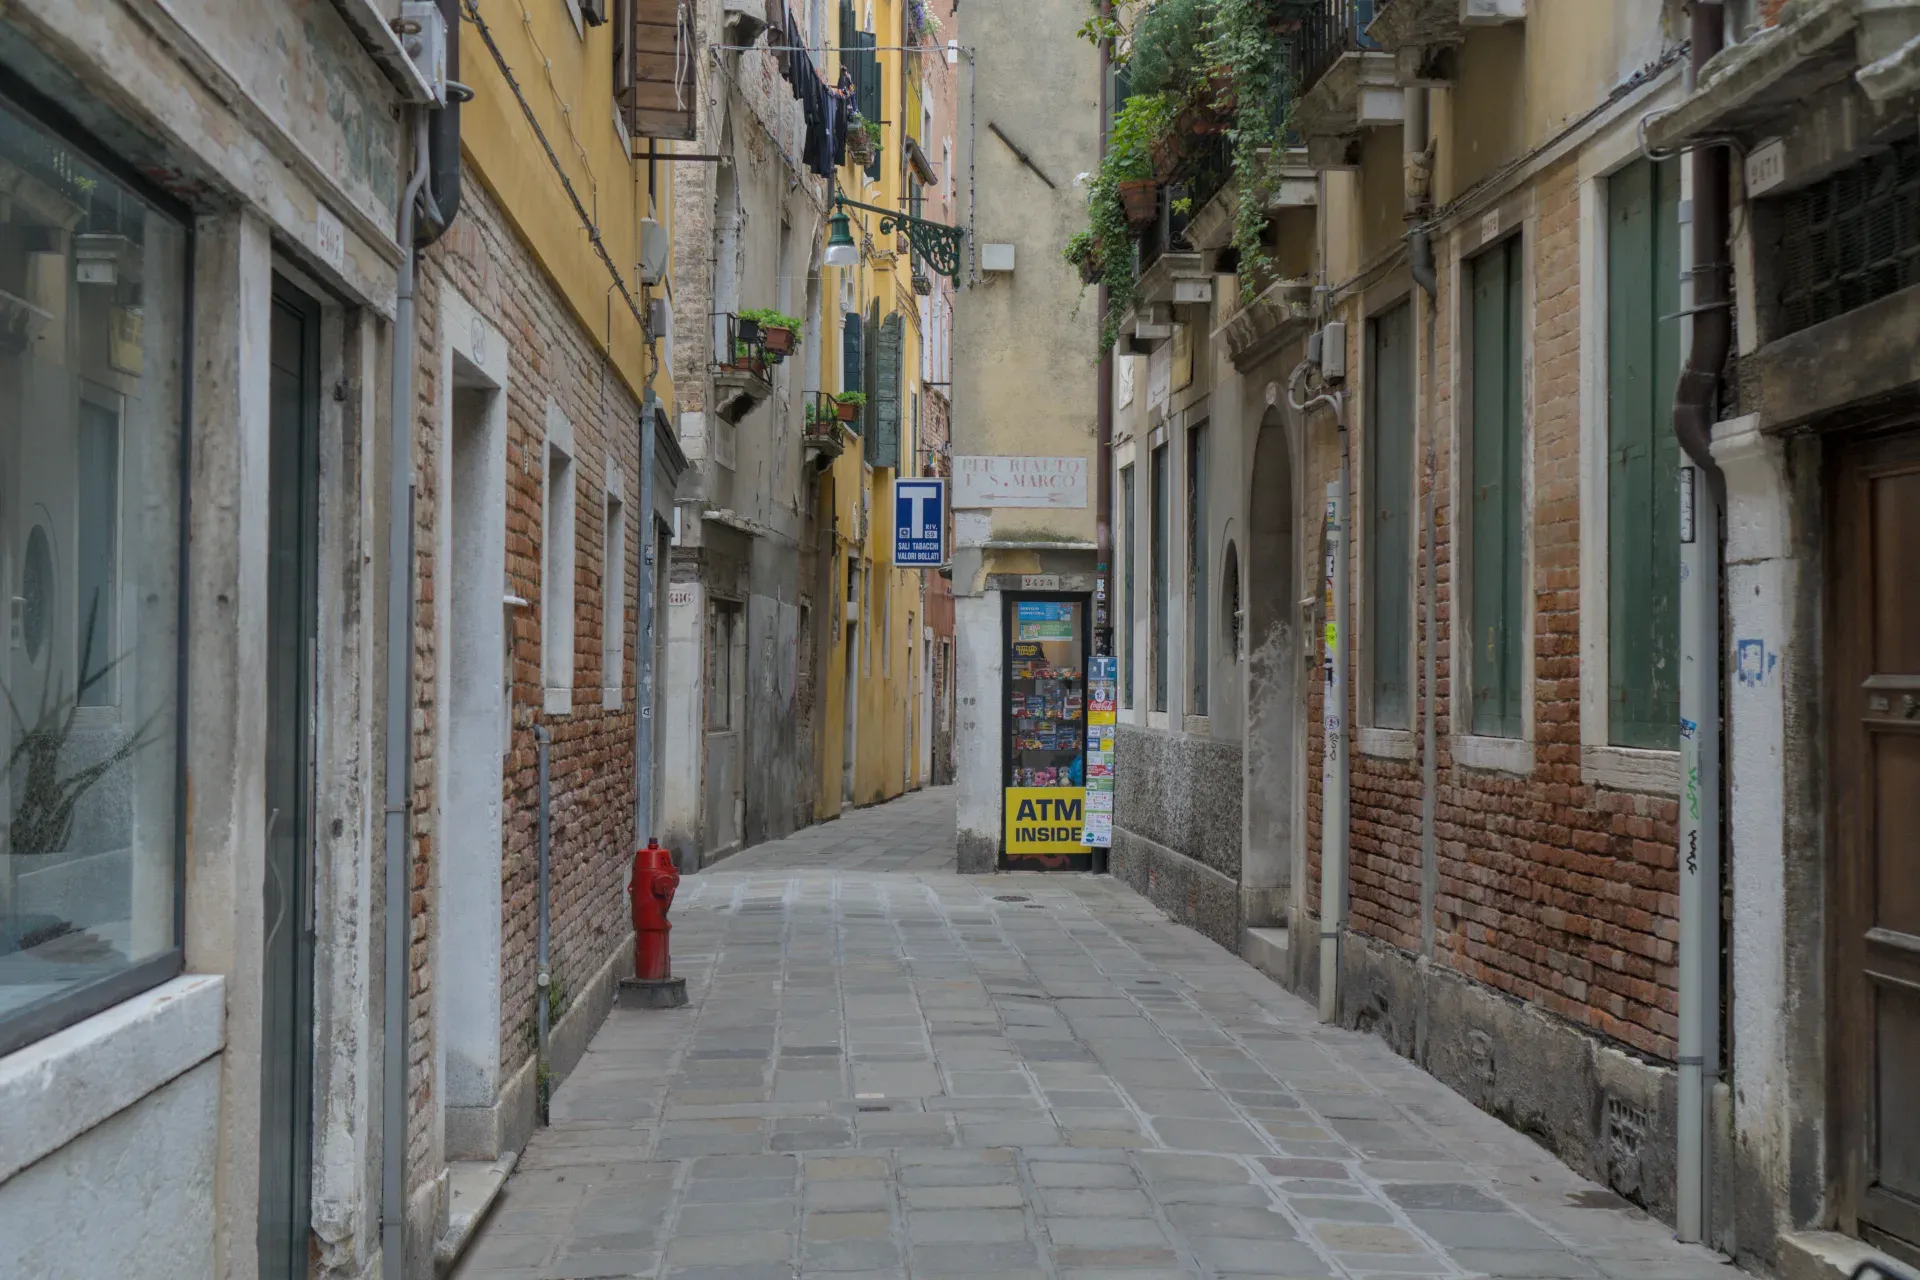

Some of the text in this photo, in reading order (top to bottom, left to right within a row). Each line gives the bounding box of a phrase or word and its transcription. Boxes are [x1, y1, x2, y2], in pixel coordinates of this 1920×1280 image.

[962, 458, 1080, 473] PER RIALTO
[899, 486, 937, 539] T
[897, 542, 939, 550] SALI TABACCHI
[897, 552, 939, 561] VALORI BOLLATI
[1024, 577, 1053, 587] 2475
[1097, 658, 1109, 677] T
[1016, 799, 1082, 821] ATM
[1016, 827, 1082, 842] INSIDE
